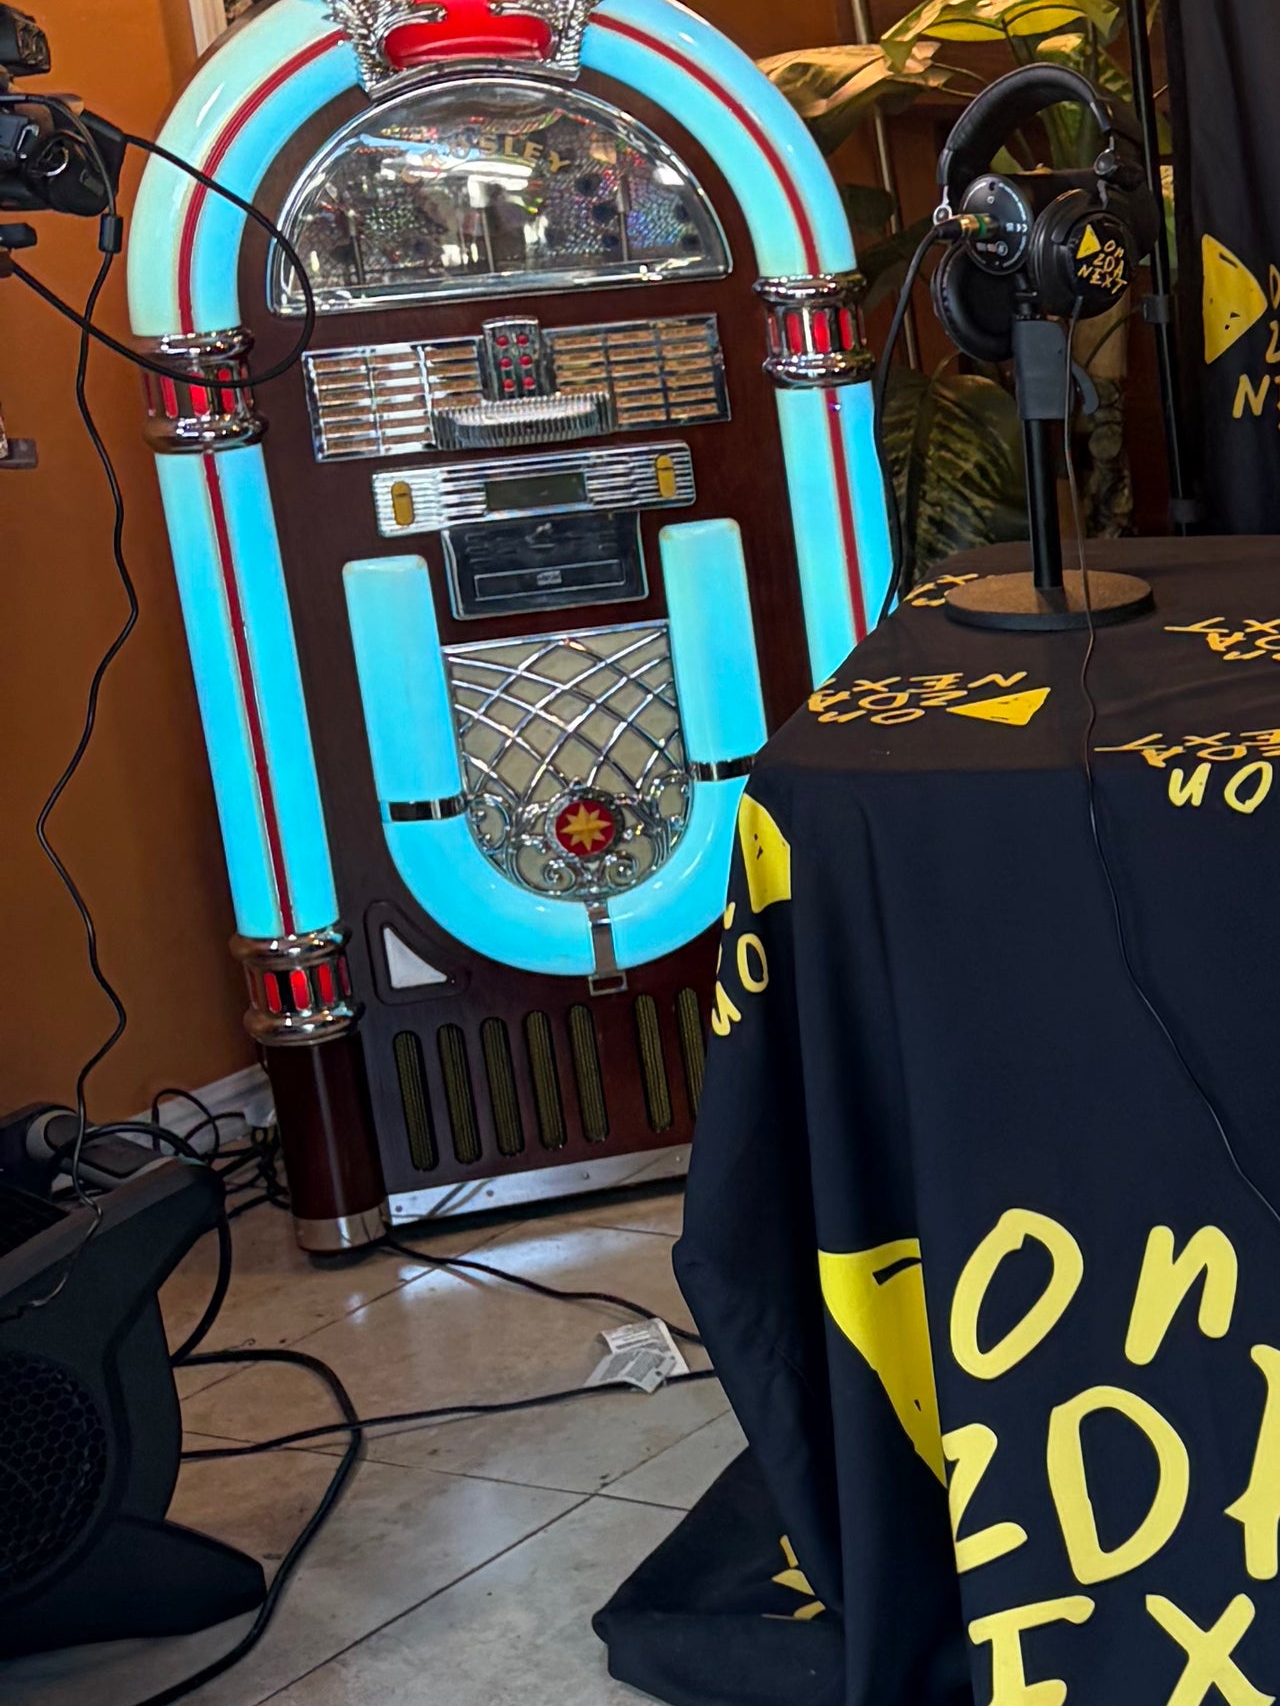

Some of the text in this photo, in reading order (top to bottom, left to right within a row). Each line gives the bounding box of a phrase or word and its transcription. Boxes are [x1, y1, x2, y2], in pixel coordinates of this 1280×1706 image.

[400, 133, 571, 185] CROSLEY
[1077, 264, 1128, 294] NEXT
[851, 670, 1029, 694] NEX
[950, 1208, 1237, 1380] On
